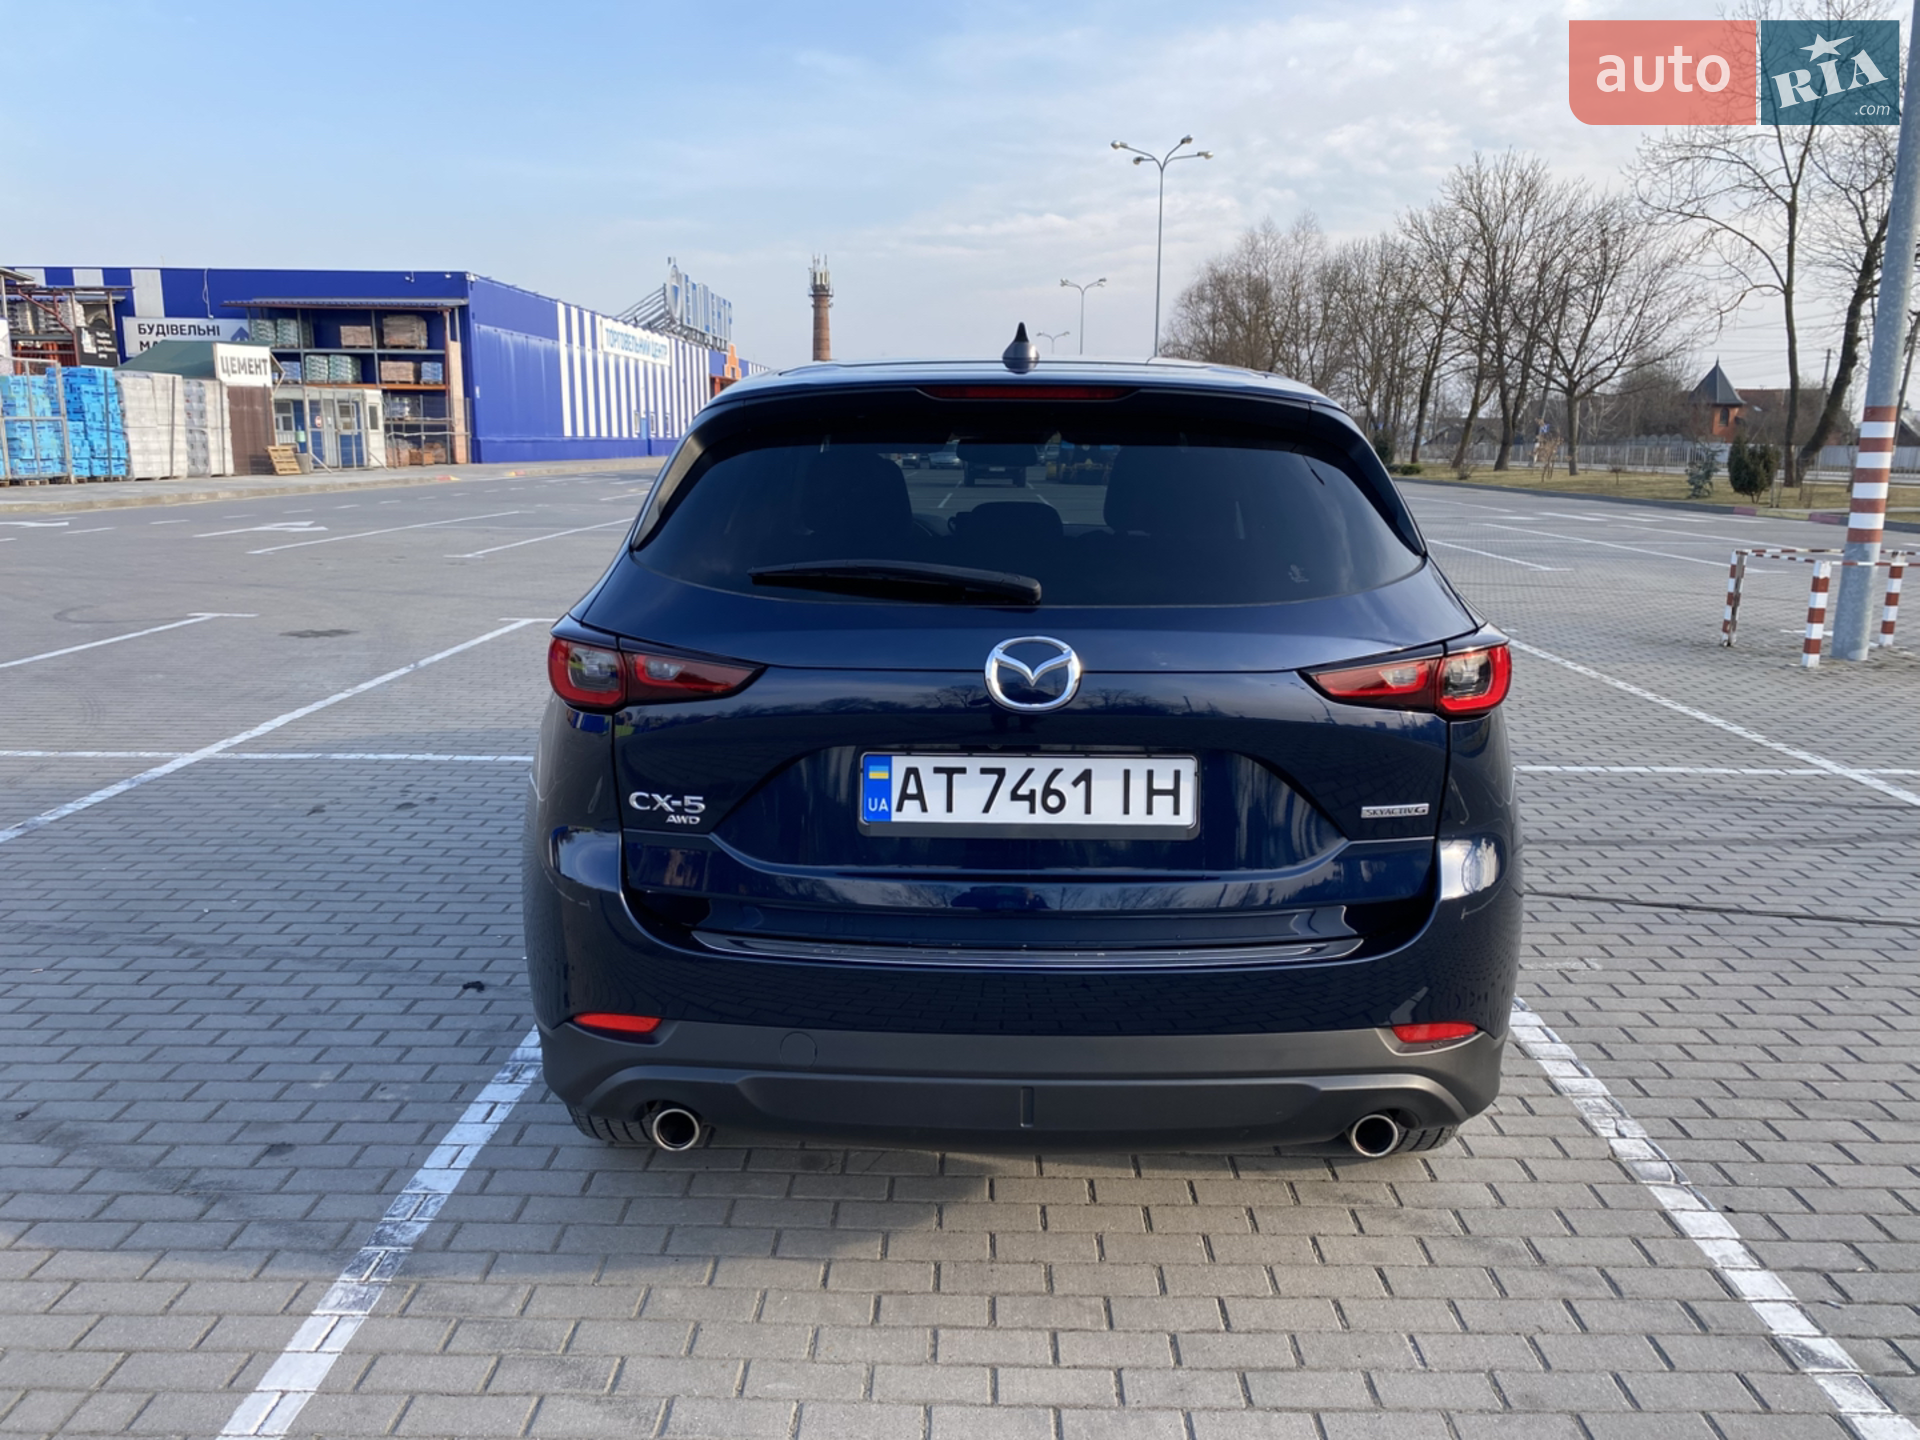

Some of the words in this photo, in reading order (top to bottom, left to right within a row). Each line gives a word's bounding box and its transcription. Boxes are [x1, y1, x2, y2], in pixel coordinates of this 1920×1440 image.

[137, 323, 221, 337] БУДІВЕЛЬНІ
[220, 355, 268, 377] ЦЕМЕНТ
[895, 766, 967, 814] AT
[979, 767, 1093, 815] 7461
[628, 791, 706, 814] CX-5
[868, 798, 889, 812] UA
[665, 814, 701, 825] AWD
